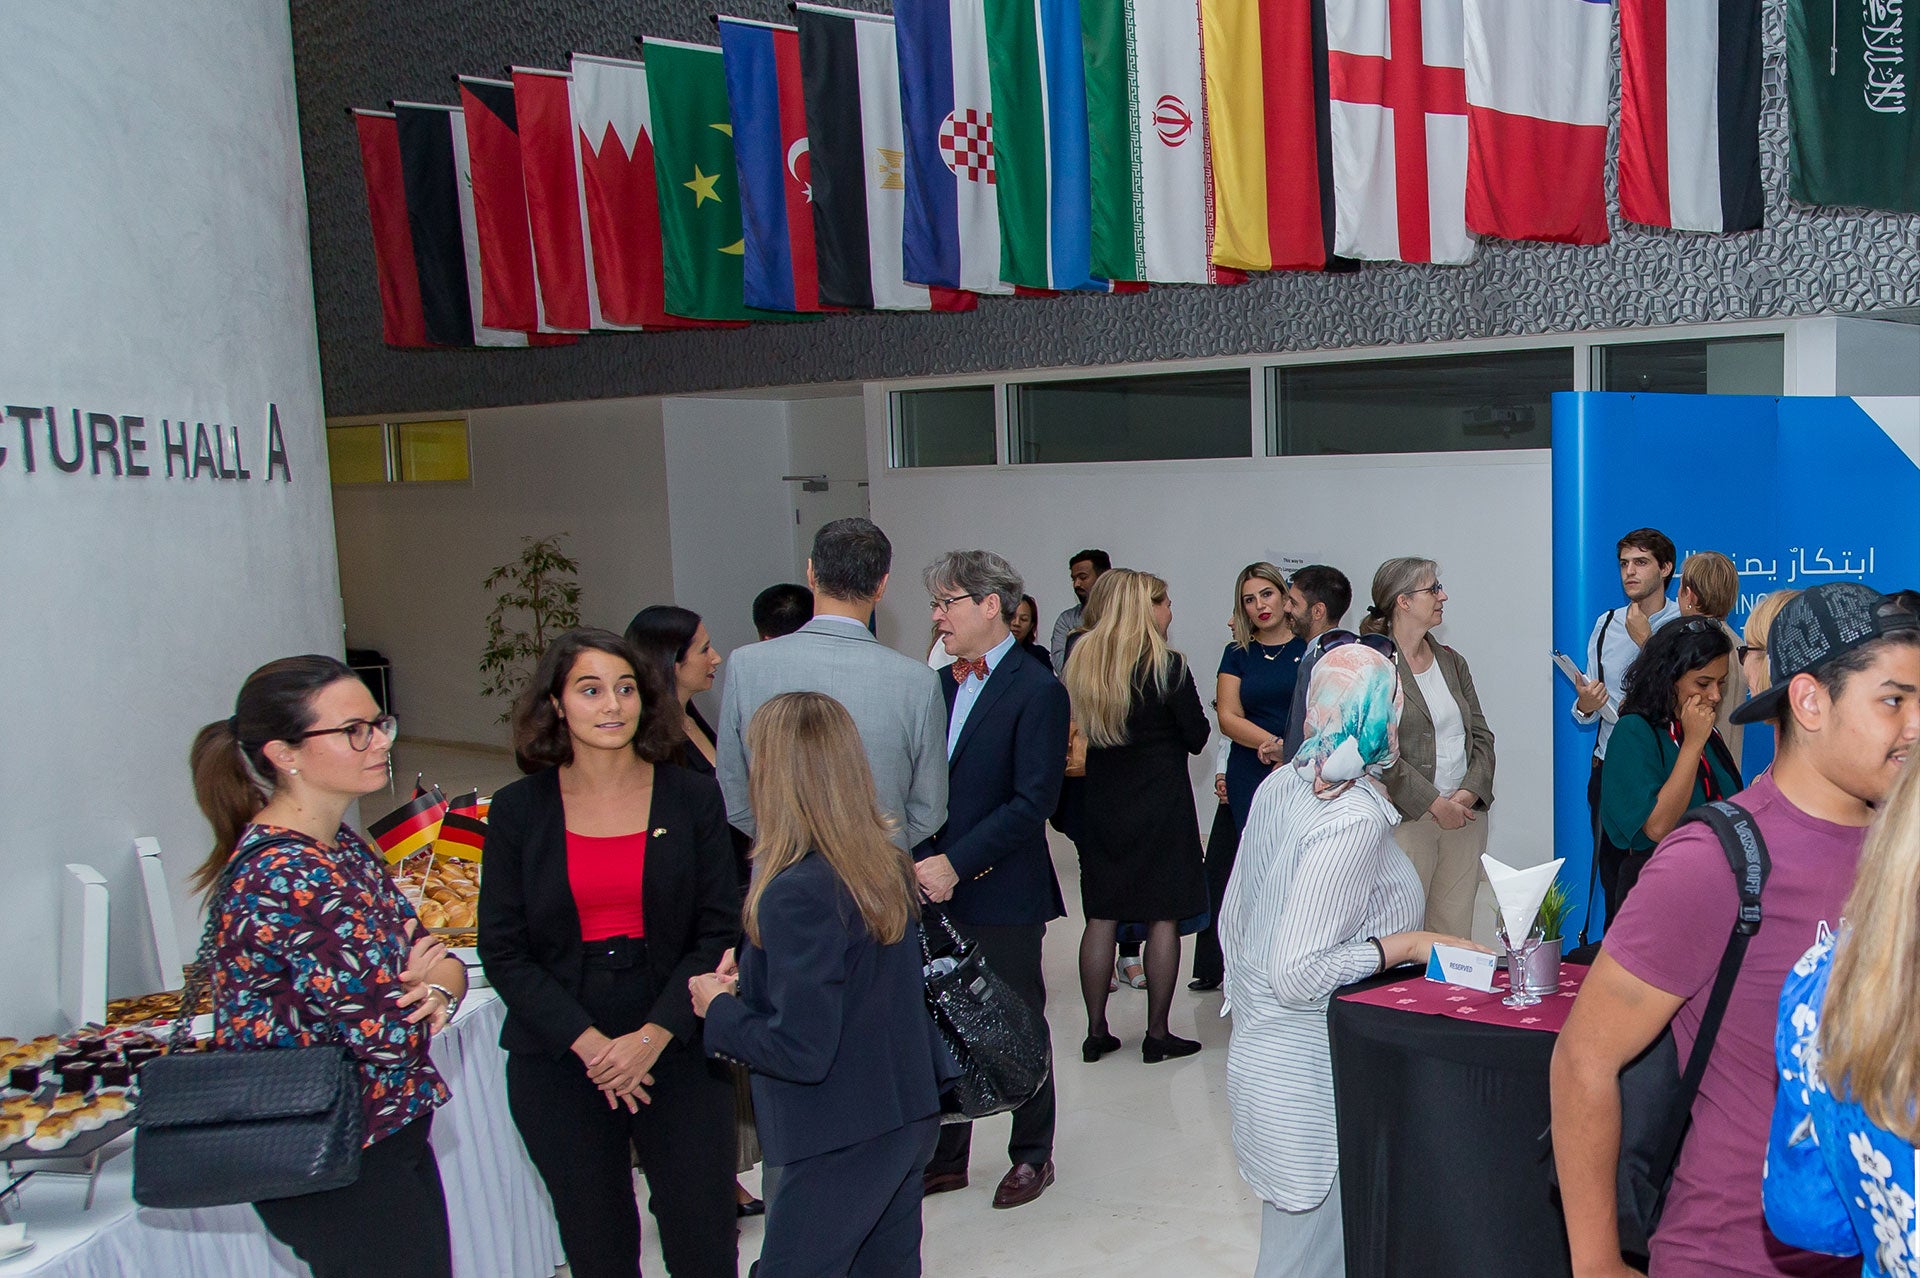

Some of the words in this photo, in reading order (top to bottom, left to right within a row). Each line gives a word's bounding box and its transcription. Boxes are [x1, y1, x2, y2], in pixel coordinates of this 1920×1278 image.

[0, 405, 150, 477] TURE
[162, 419, 251, 479] HALL
[266, 401, 292, 482] A
[1449, 961, 1473, 973] RESERVED
